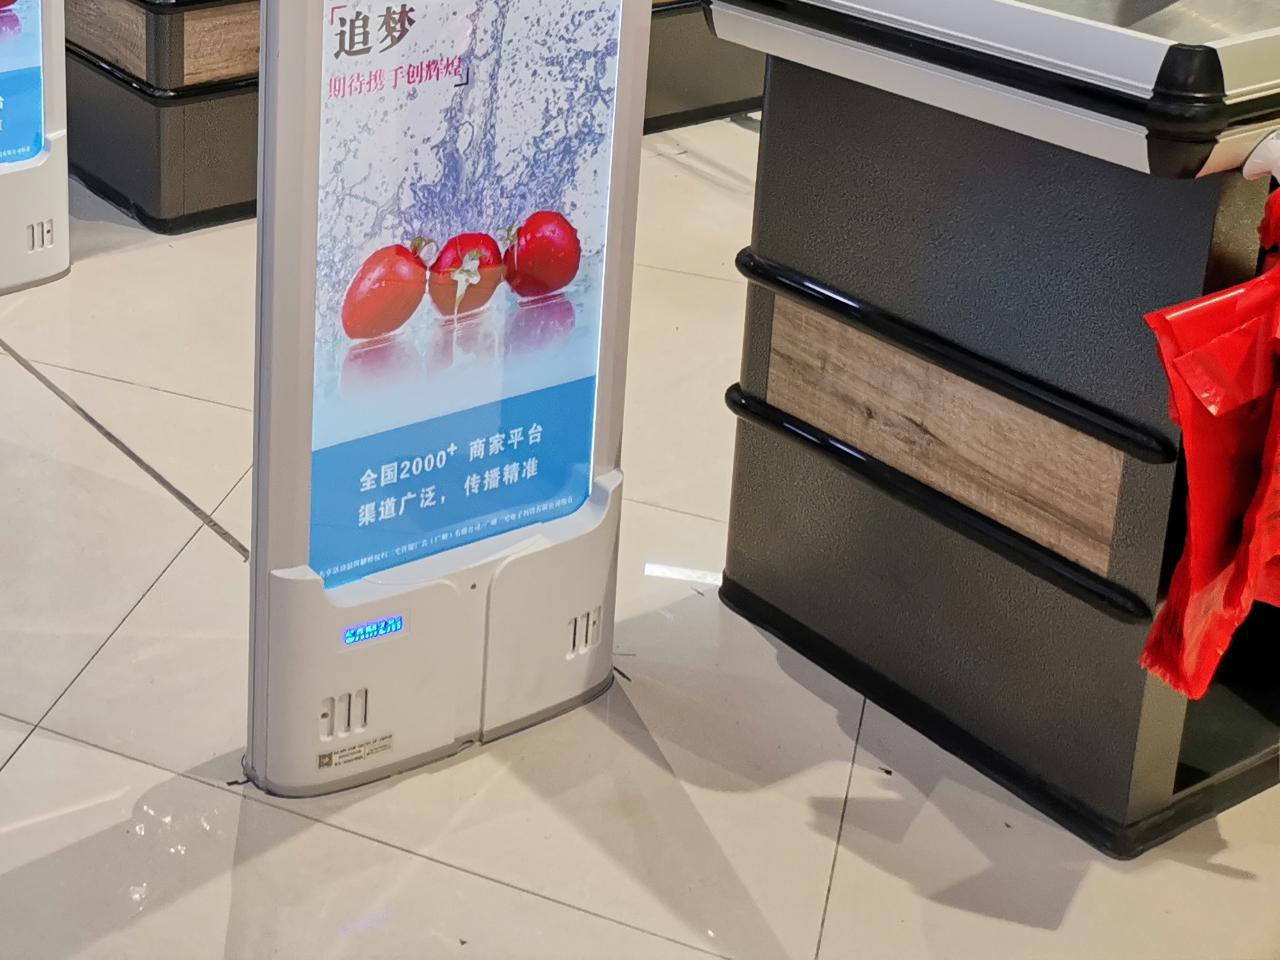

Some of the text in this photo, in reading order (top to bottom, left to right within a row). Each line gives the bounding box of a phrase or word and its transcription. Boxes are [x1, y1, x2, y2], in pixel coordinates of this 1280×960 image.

[333, 3, 416, 60] 追梦
[327, 54, 463, 101] 期待携手创辉煌
[468, 422, 544, 462] 商家平台
[463, 457, 540, 497] 传播精准
